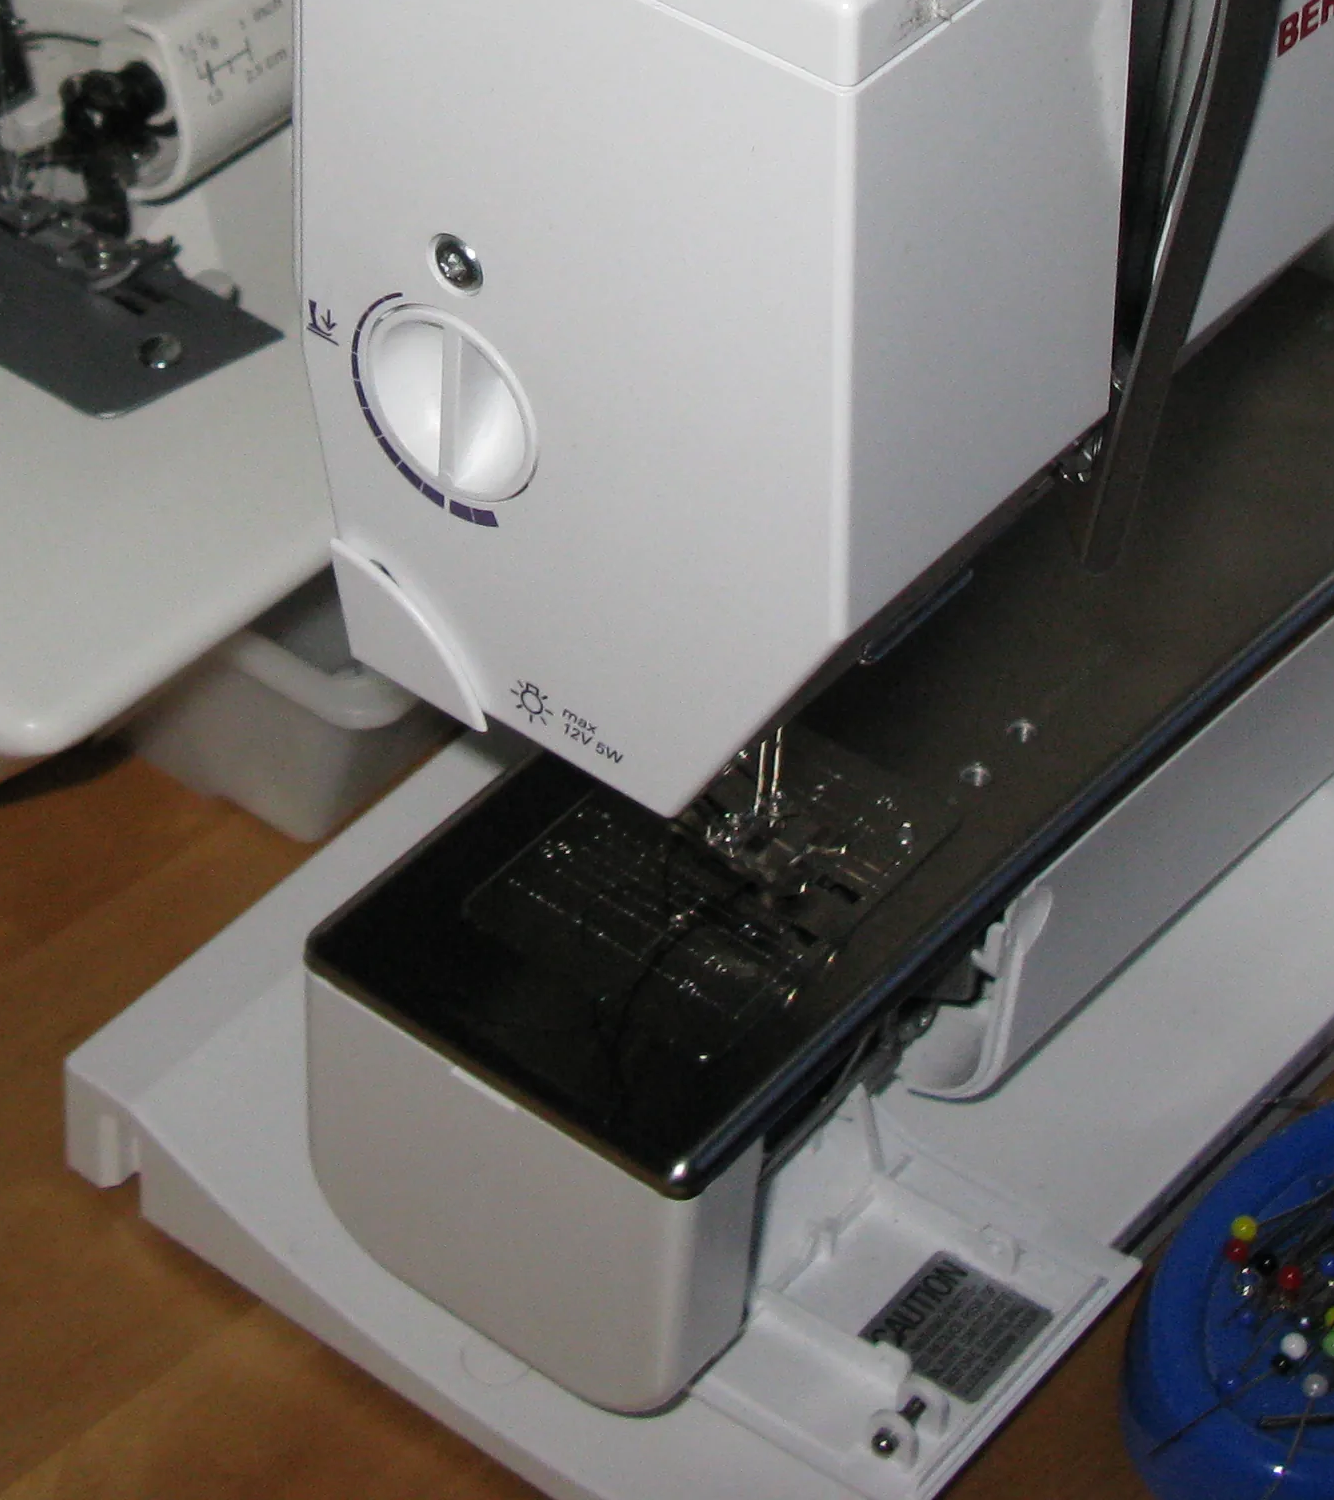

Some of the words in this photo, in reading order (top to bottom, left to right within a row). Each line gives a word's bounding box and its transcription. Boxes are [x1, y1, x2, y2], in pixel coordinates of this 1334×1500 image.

[561, 708, 598, 735] max
[563, 722, 593, 746] 12V
[595, 742, 624, 764] 5W
